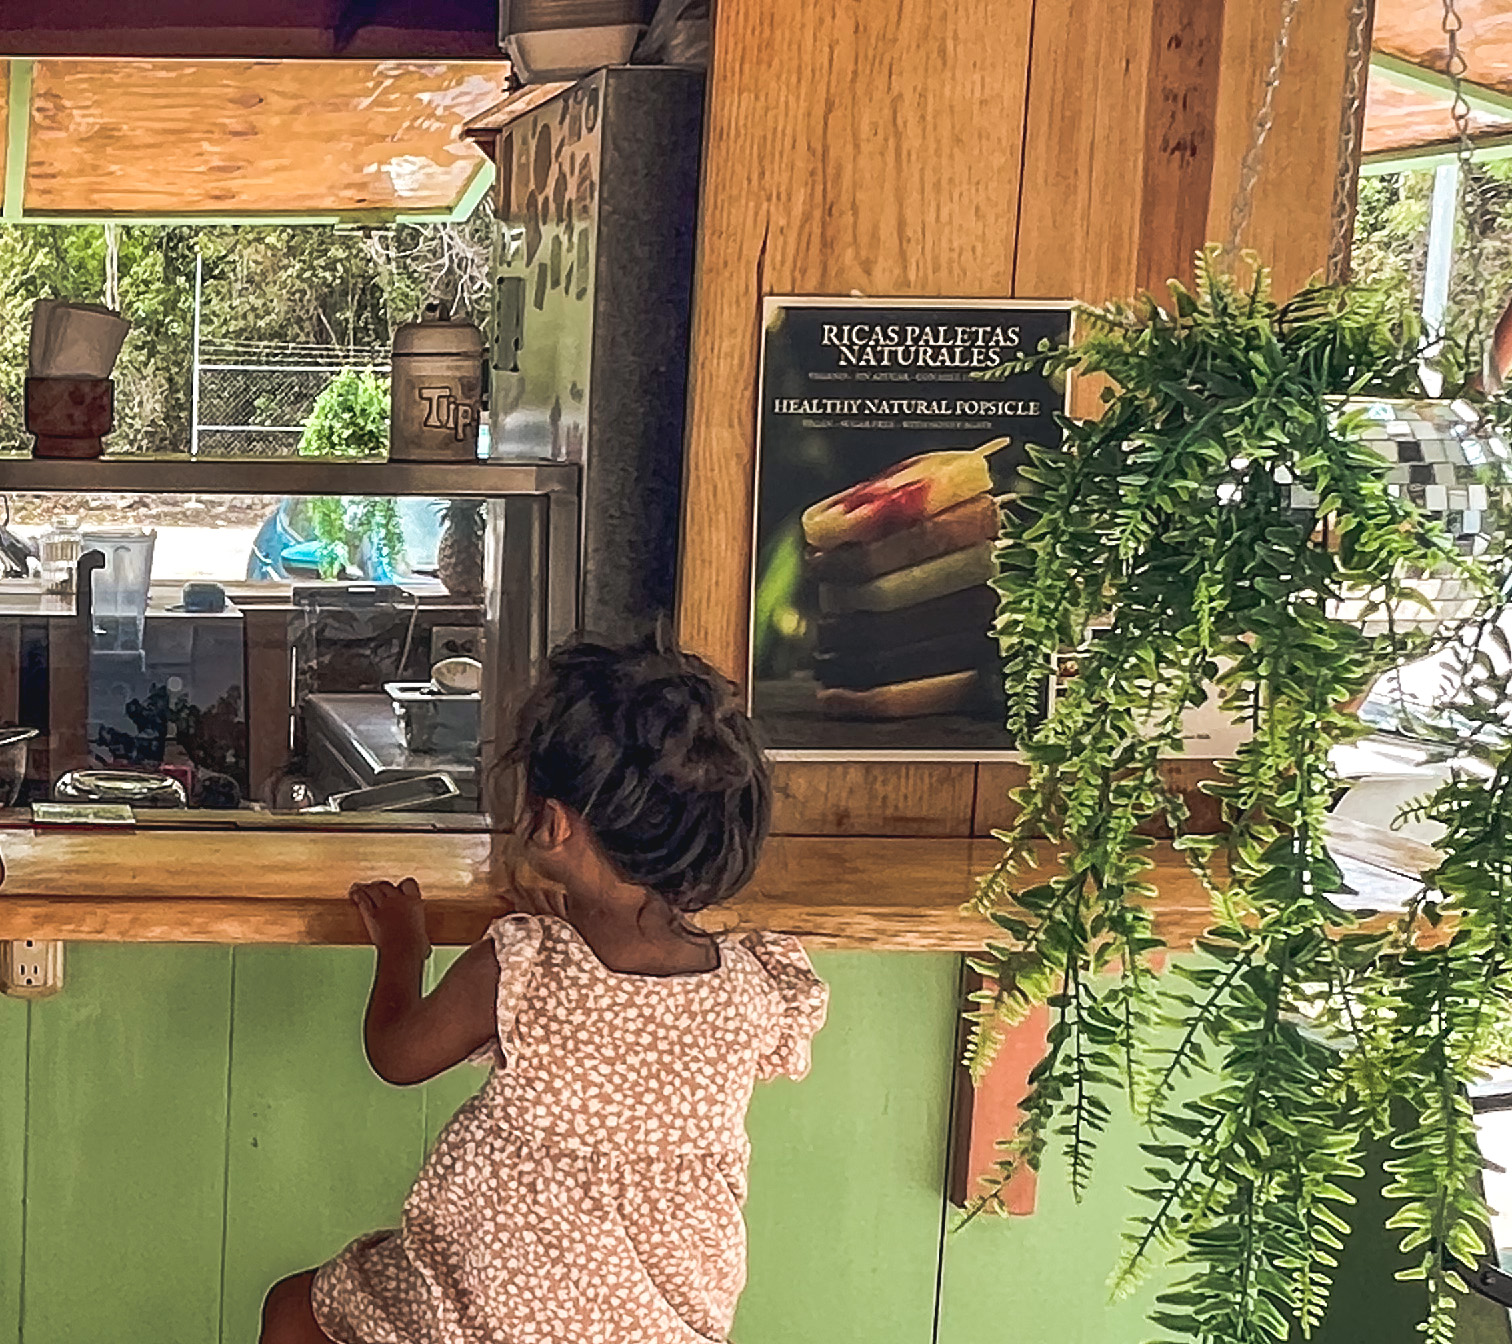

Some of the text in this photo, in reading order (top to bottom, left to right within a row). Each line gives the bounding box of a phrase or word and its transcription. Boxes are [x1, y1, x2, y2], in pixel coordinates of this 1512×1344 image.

[821, 324, 1021, 347] RICAS PALETAS
[838, 345, 1002, 368] NATURALES
[418, 385, 473, 442] Tip
[773, 398, 1041, 417] HEALTHY NATURAL POPSICLE
